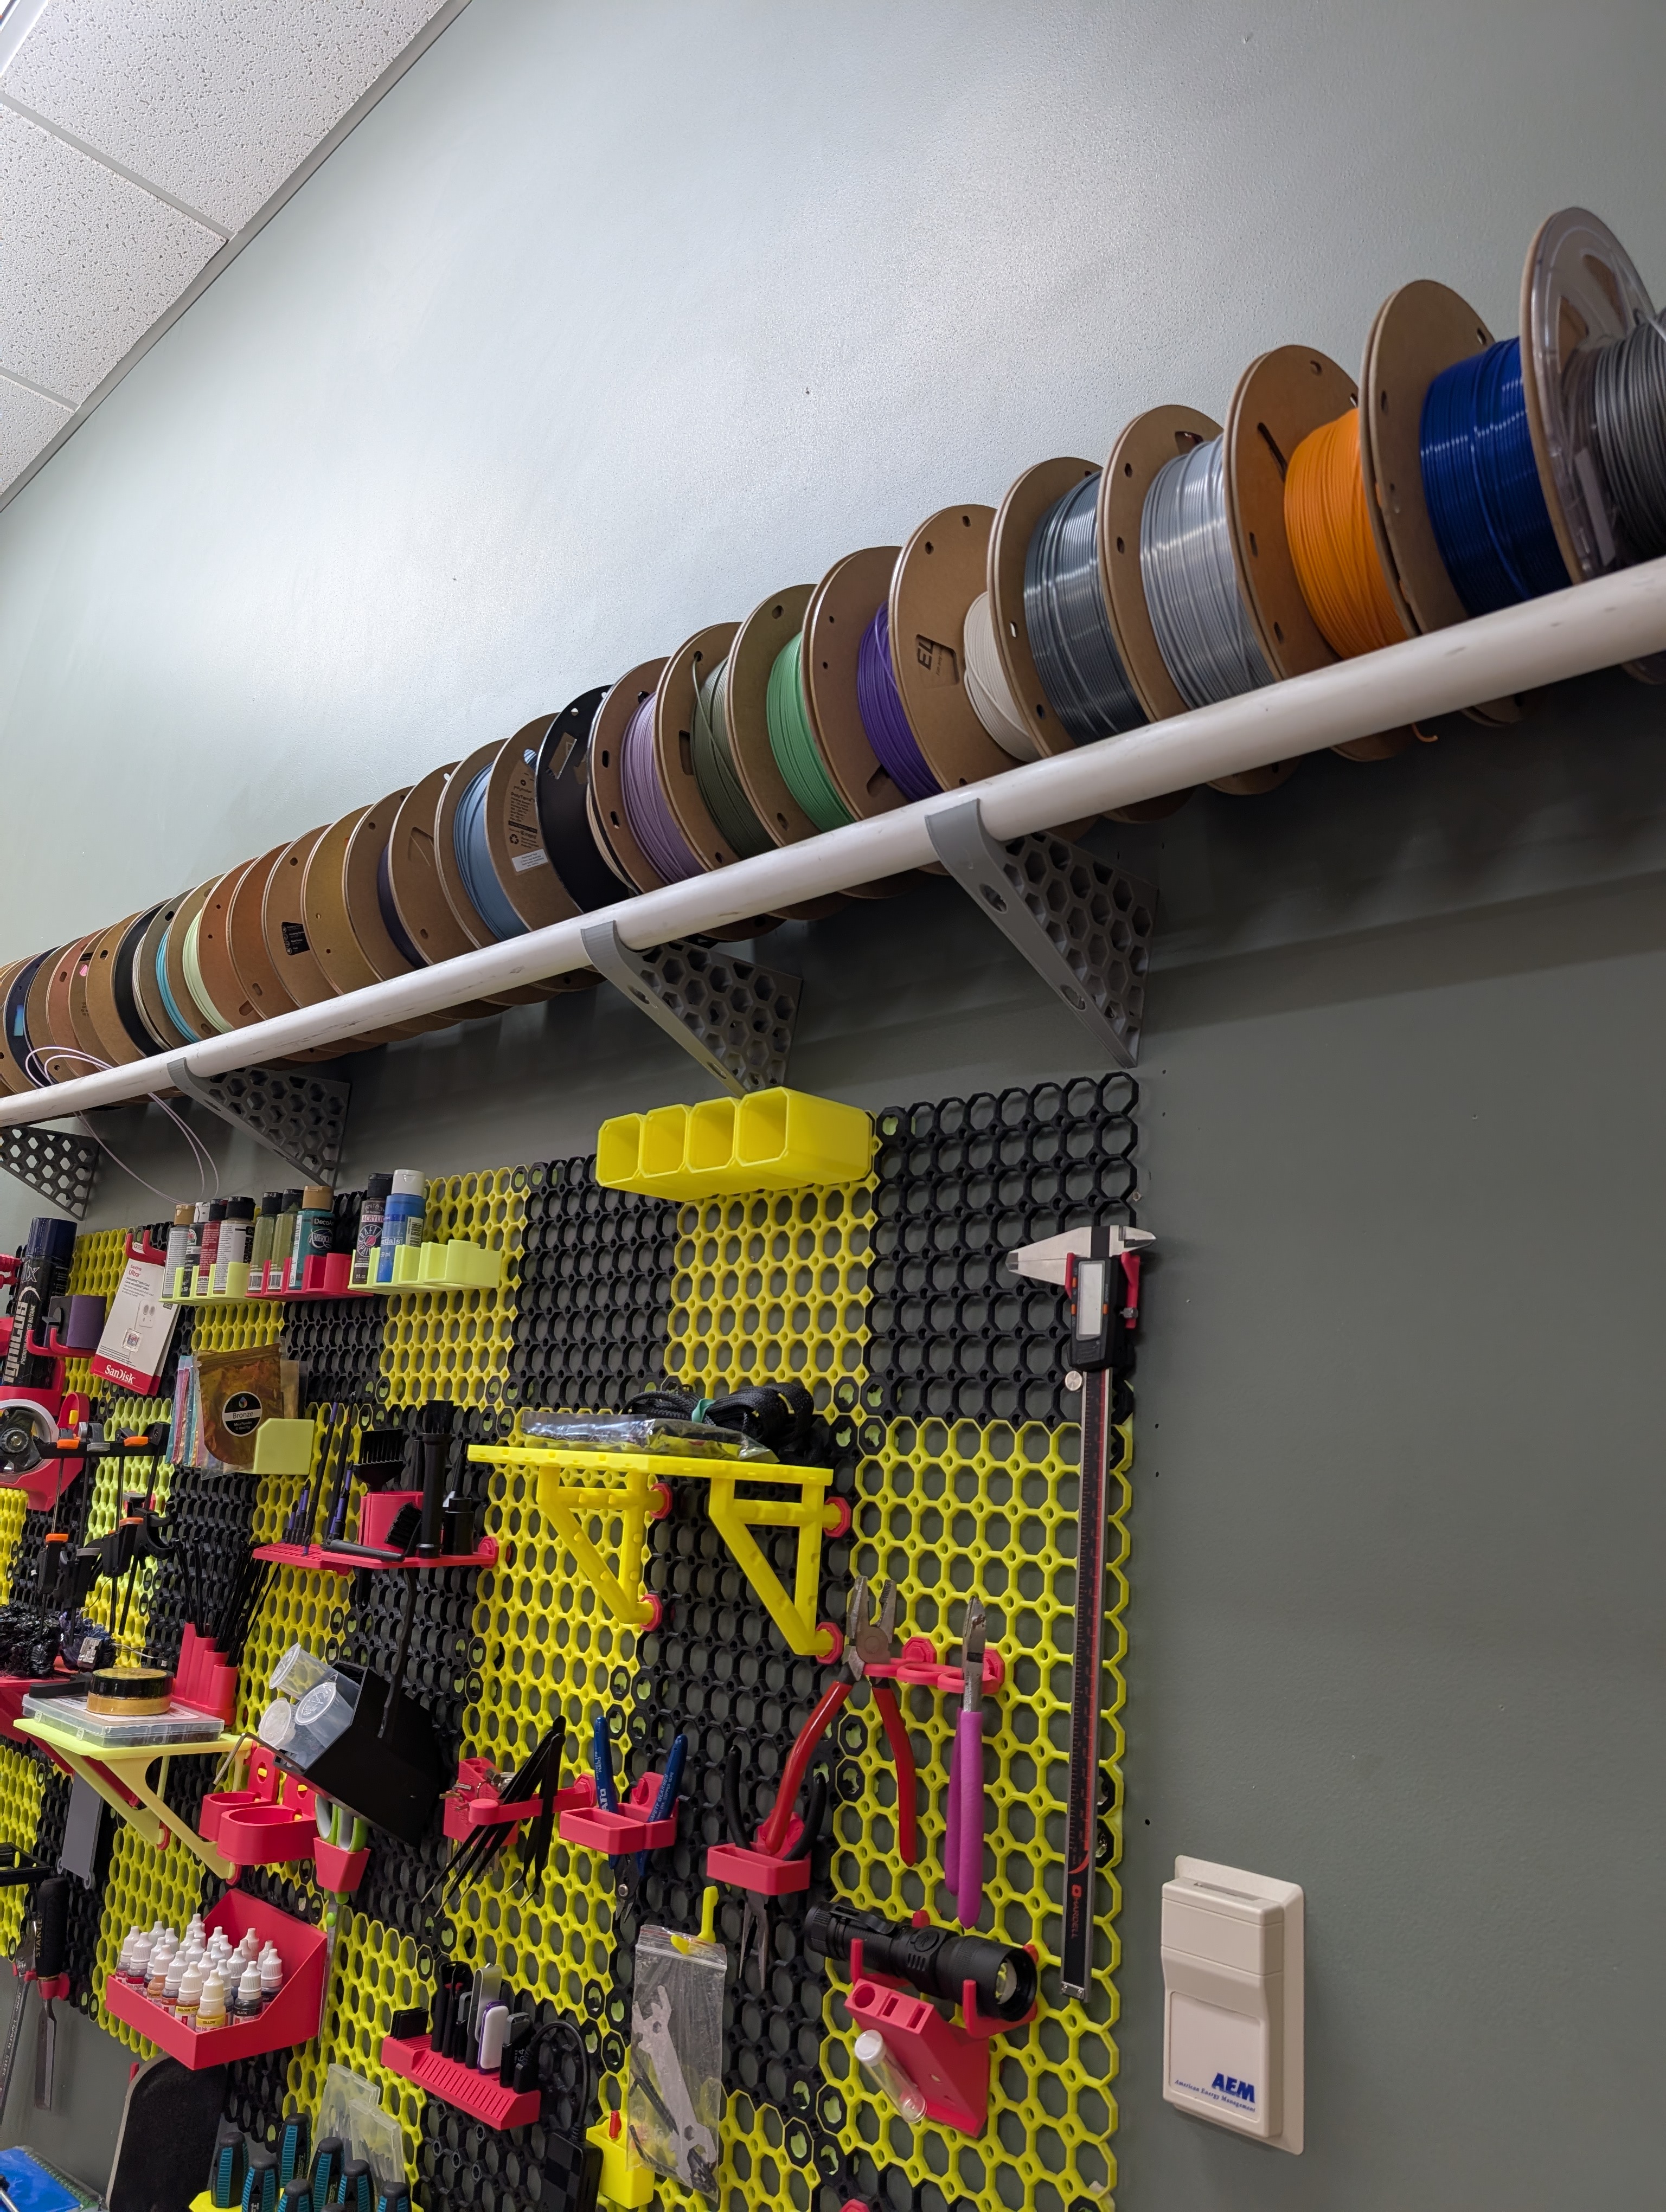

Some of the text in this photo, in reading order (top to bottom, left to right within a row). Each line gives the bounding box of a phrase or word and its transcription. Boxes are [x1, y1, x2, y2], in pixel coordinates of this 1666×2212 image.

[314, 1218, 334, 1226] DecoAr
[105, 1364, 136, 1384] SanDisk
[649, 1802, 659, 1822] SAFETY
[658, 1773, 668, 1802] GLASSES
[1175, 2079, 1255, 2112] American Energy Management
[1212, 2072, 1255, 2104] AEM
